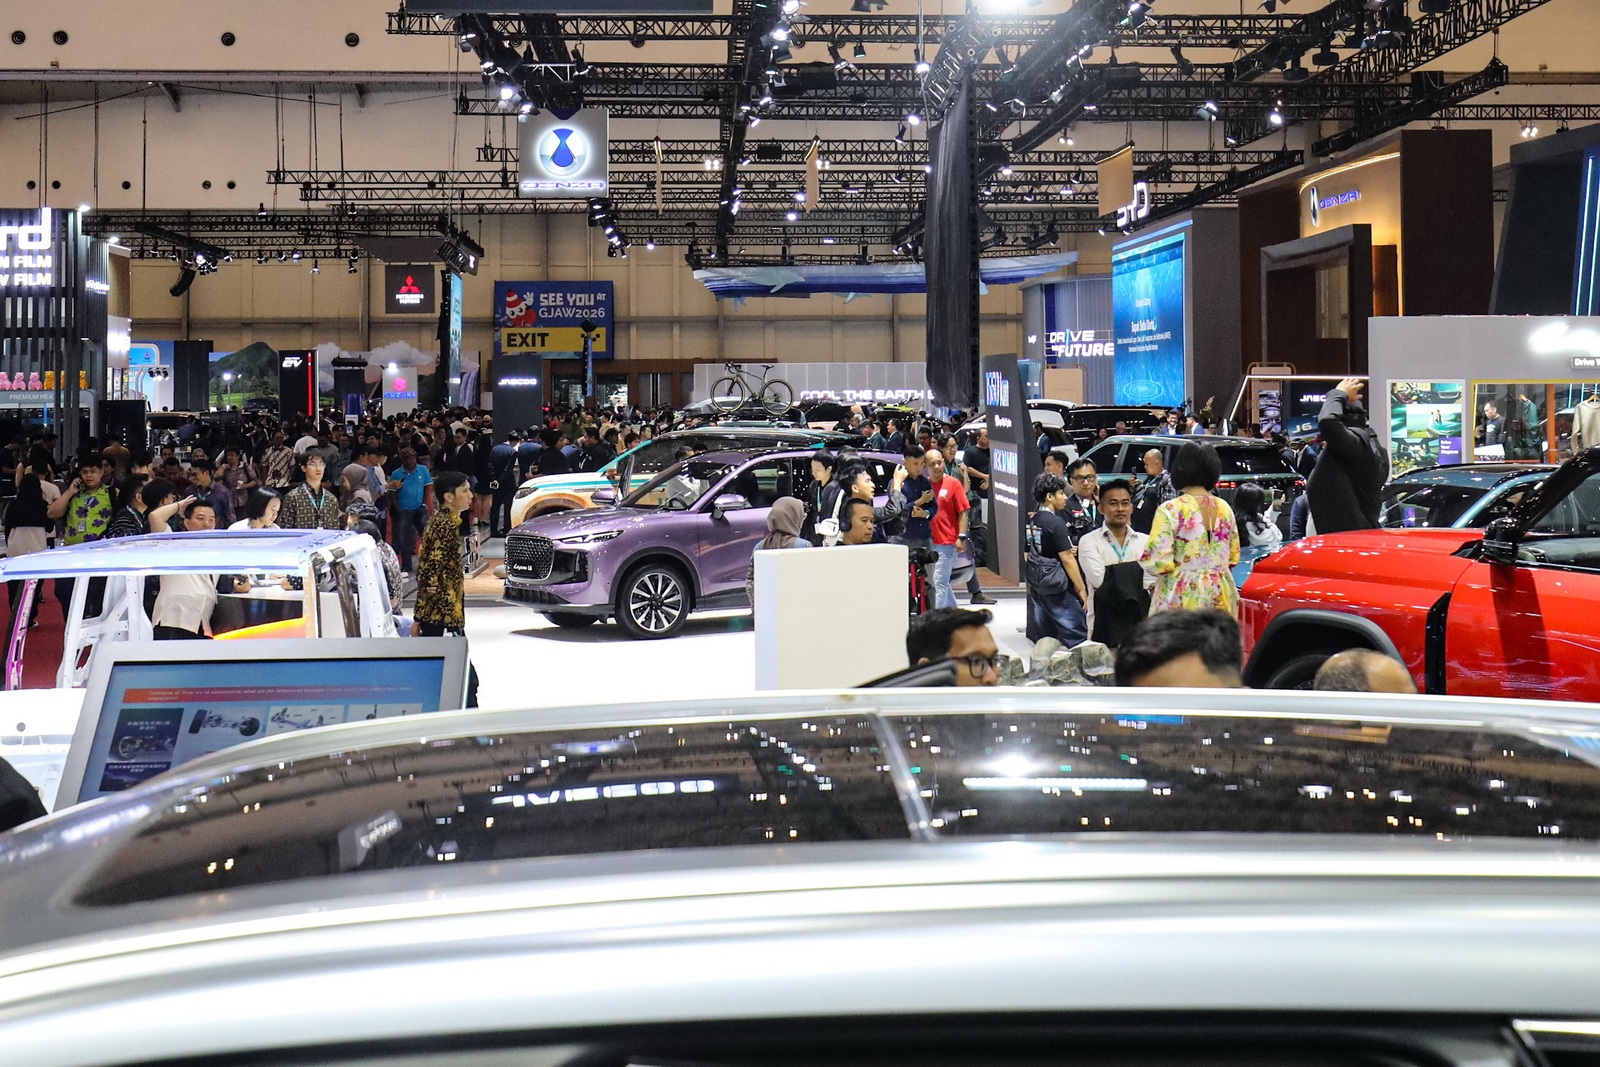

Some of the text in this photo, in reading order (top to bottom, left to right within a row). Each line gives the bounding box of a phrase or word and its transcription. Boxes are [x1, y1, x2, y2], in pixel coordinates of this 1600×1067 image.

[522, 181, 604, 190] DENZA
[1320, 190, 1361, 209] DENZA
[14, 255, 52, 268] FILM
[14, 273, 52, 286] FILM
[540, 292, 606, 306] SEE YOU AT
[538, 307, 606, 318] GJAW2026
[506, 332, 549, 348] EXIT
[1050, 329, 1095, 344] DRIVE
[1058, 342, 1115, 358] FUTURE
[1574, 358, 1595, 367] Drive
[498, 378, 538, 386] JAECOO
[800, 390, 840, 400] COOL
[843, 389, 868, 400] THE
[875, 389, 924, 400] EARTH
[1292, 422, 1312, 434] J6
